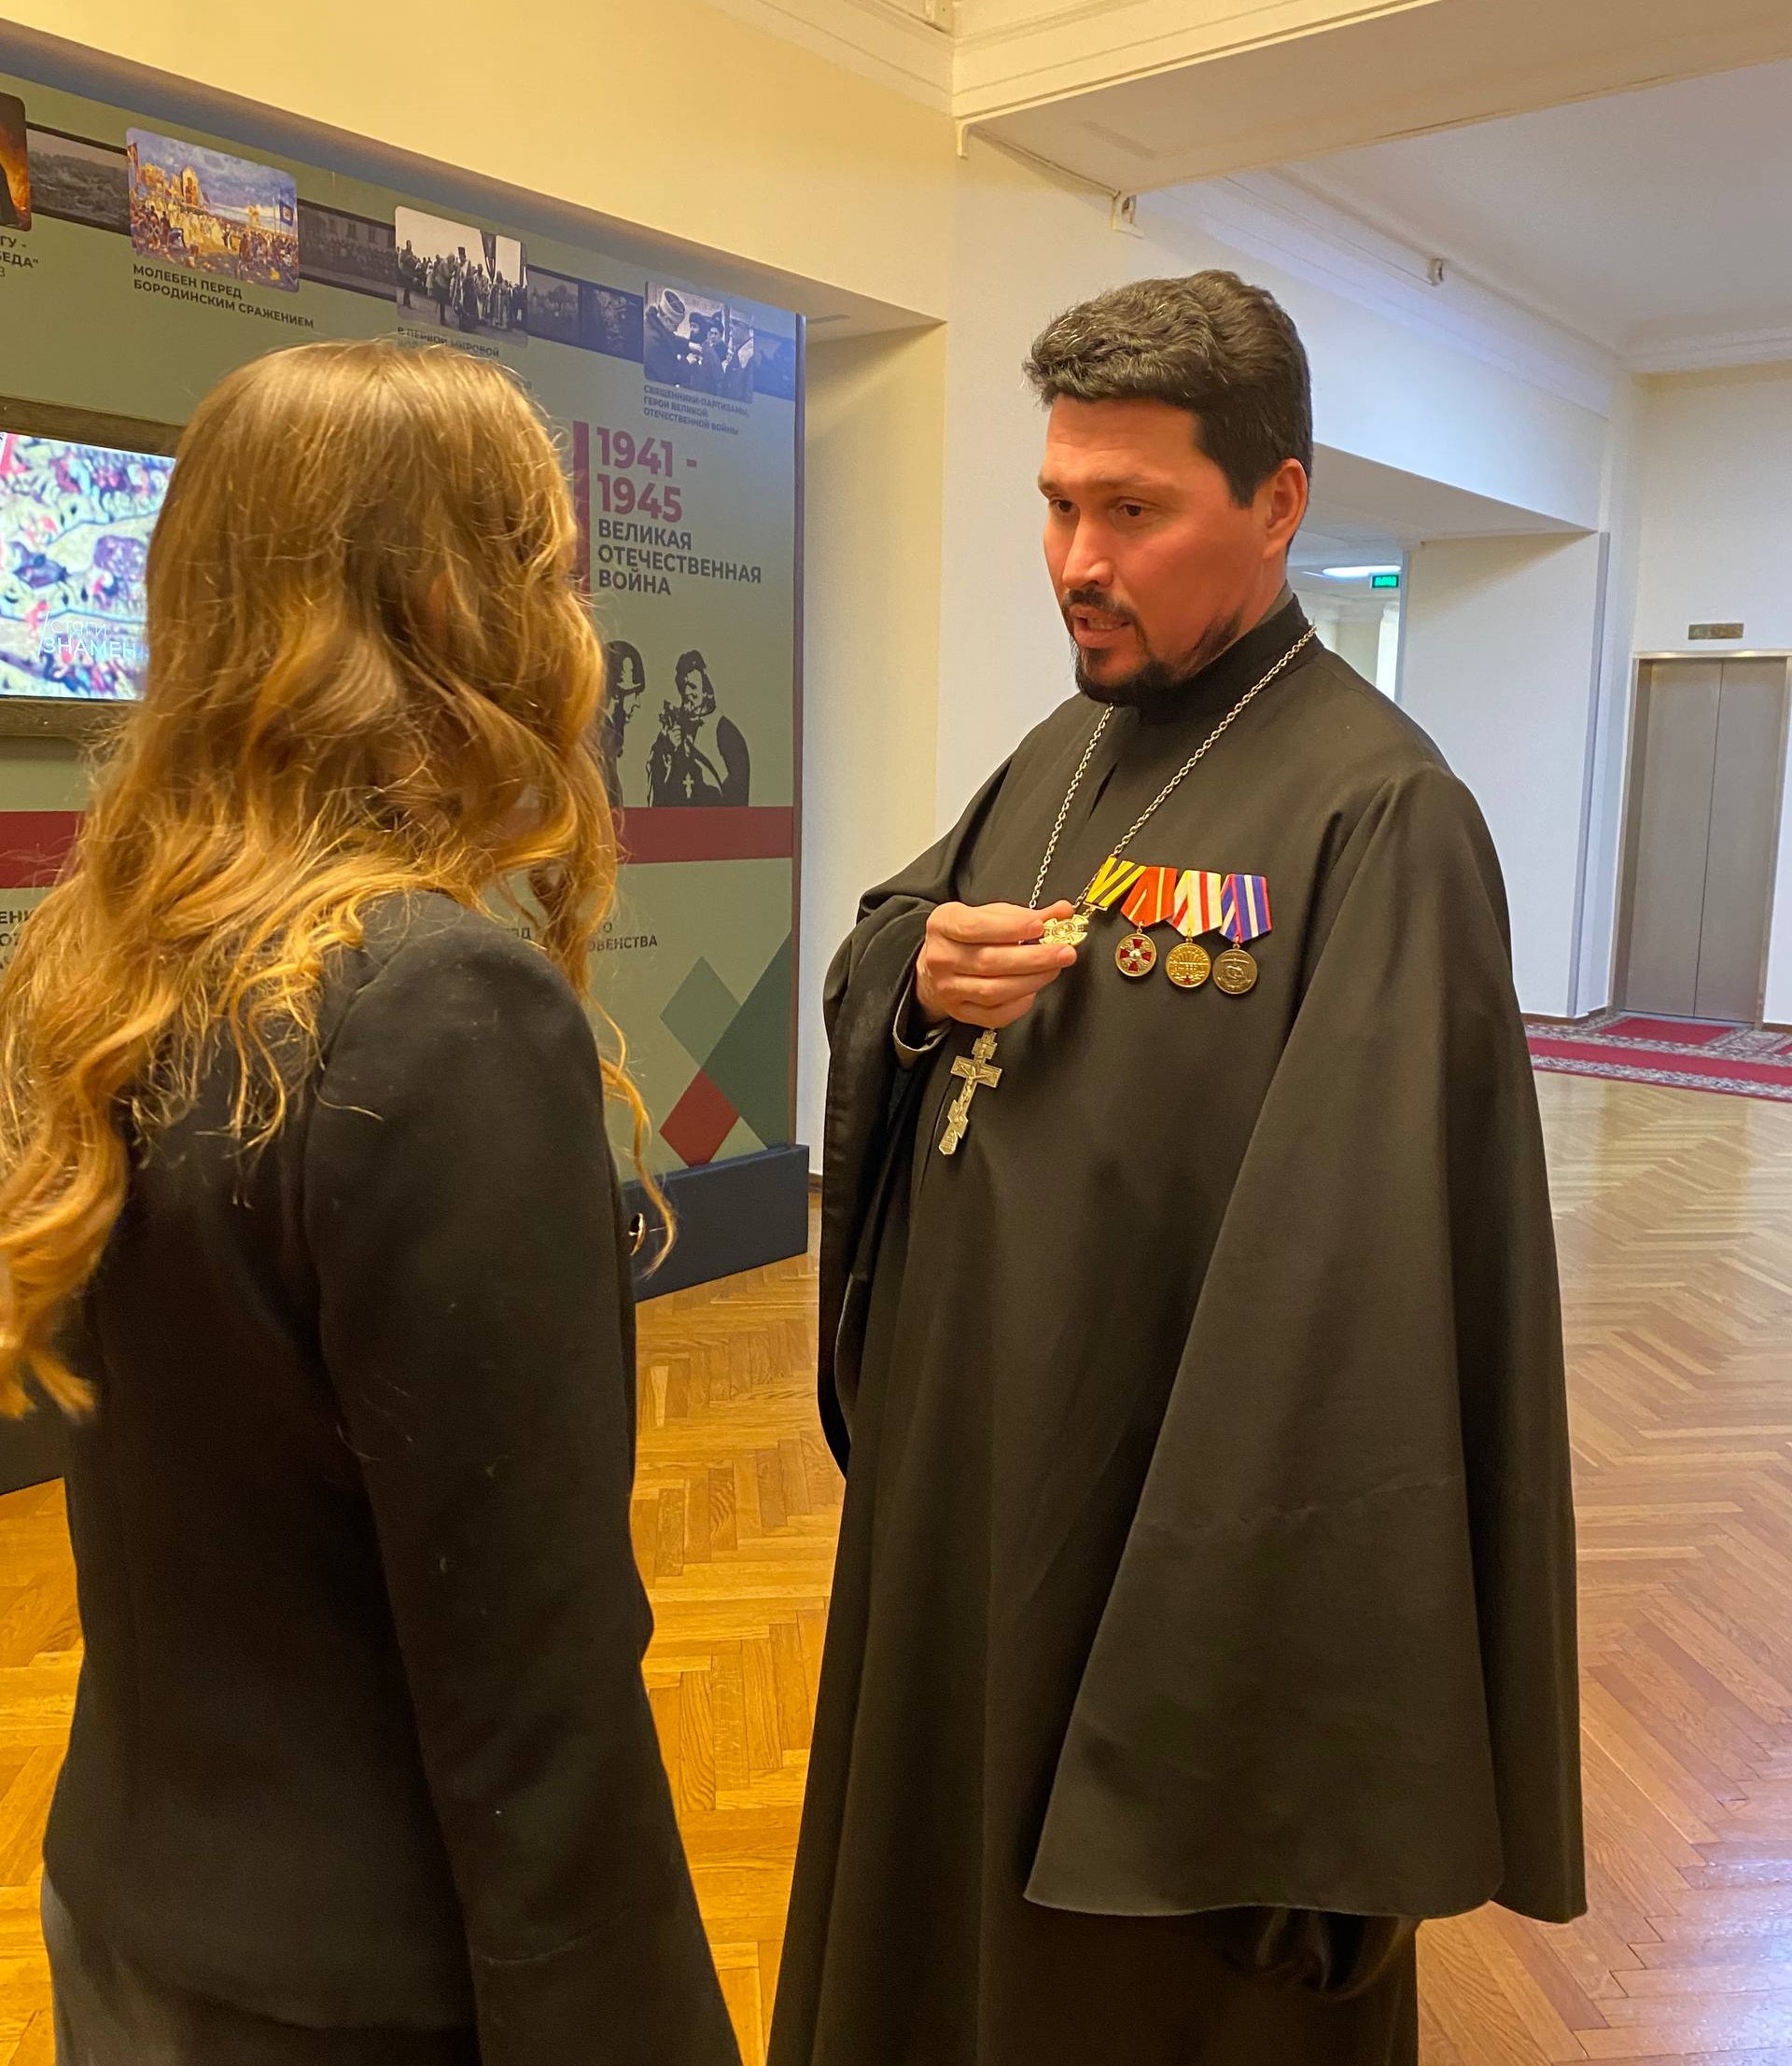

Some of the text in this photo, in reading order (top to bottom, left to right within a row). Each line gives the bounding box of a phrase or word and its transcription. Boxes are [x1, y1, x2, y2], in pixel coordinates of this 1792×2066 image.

[0, 250, 39, 269] ЕДА"
[133, 264, 243, 300] МОЛЕБЕН ПЕРЕД
[133, 279, 315, 328] БОРОДИНСКИМ СРАЖЕНИЕМ
[643, 396, 708, 418] ГЕРОИ ВЕЛИКОЙ
[643, 407, 710, 429] ОТЕЧЕСТВЕННОЙ
[596, 426, 673, 478] 1941
[596, 473, 682, 523] 1945
[598, 518, 693, 551] ВЕЛИКАЯ
[597, 544, 762, 584] ОТЕЧЕСТВЕННАЯ
[598, 567, 672, 595] ВОЙНА
